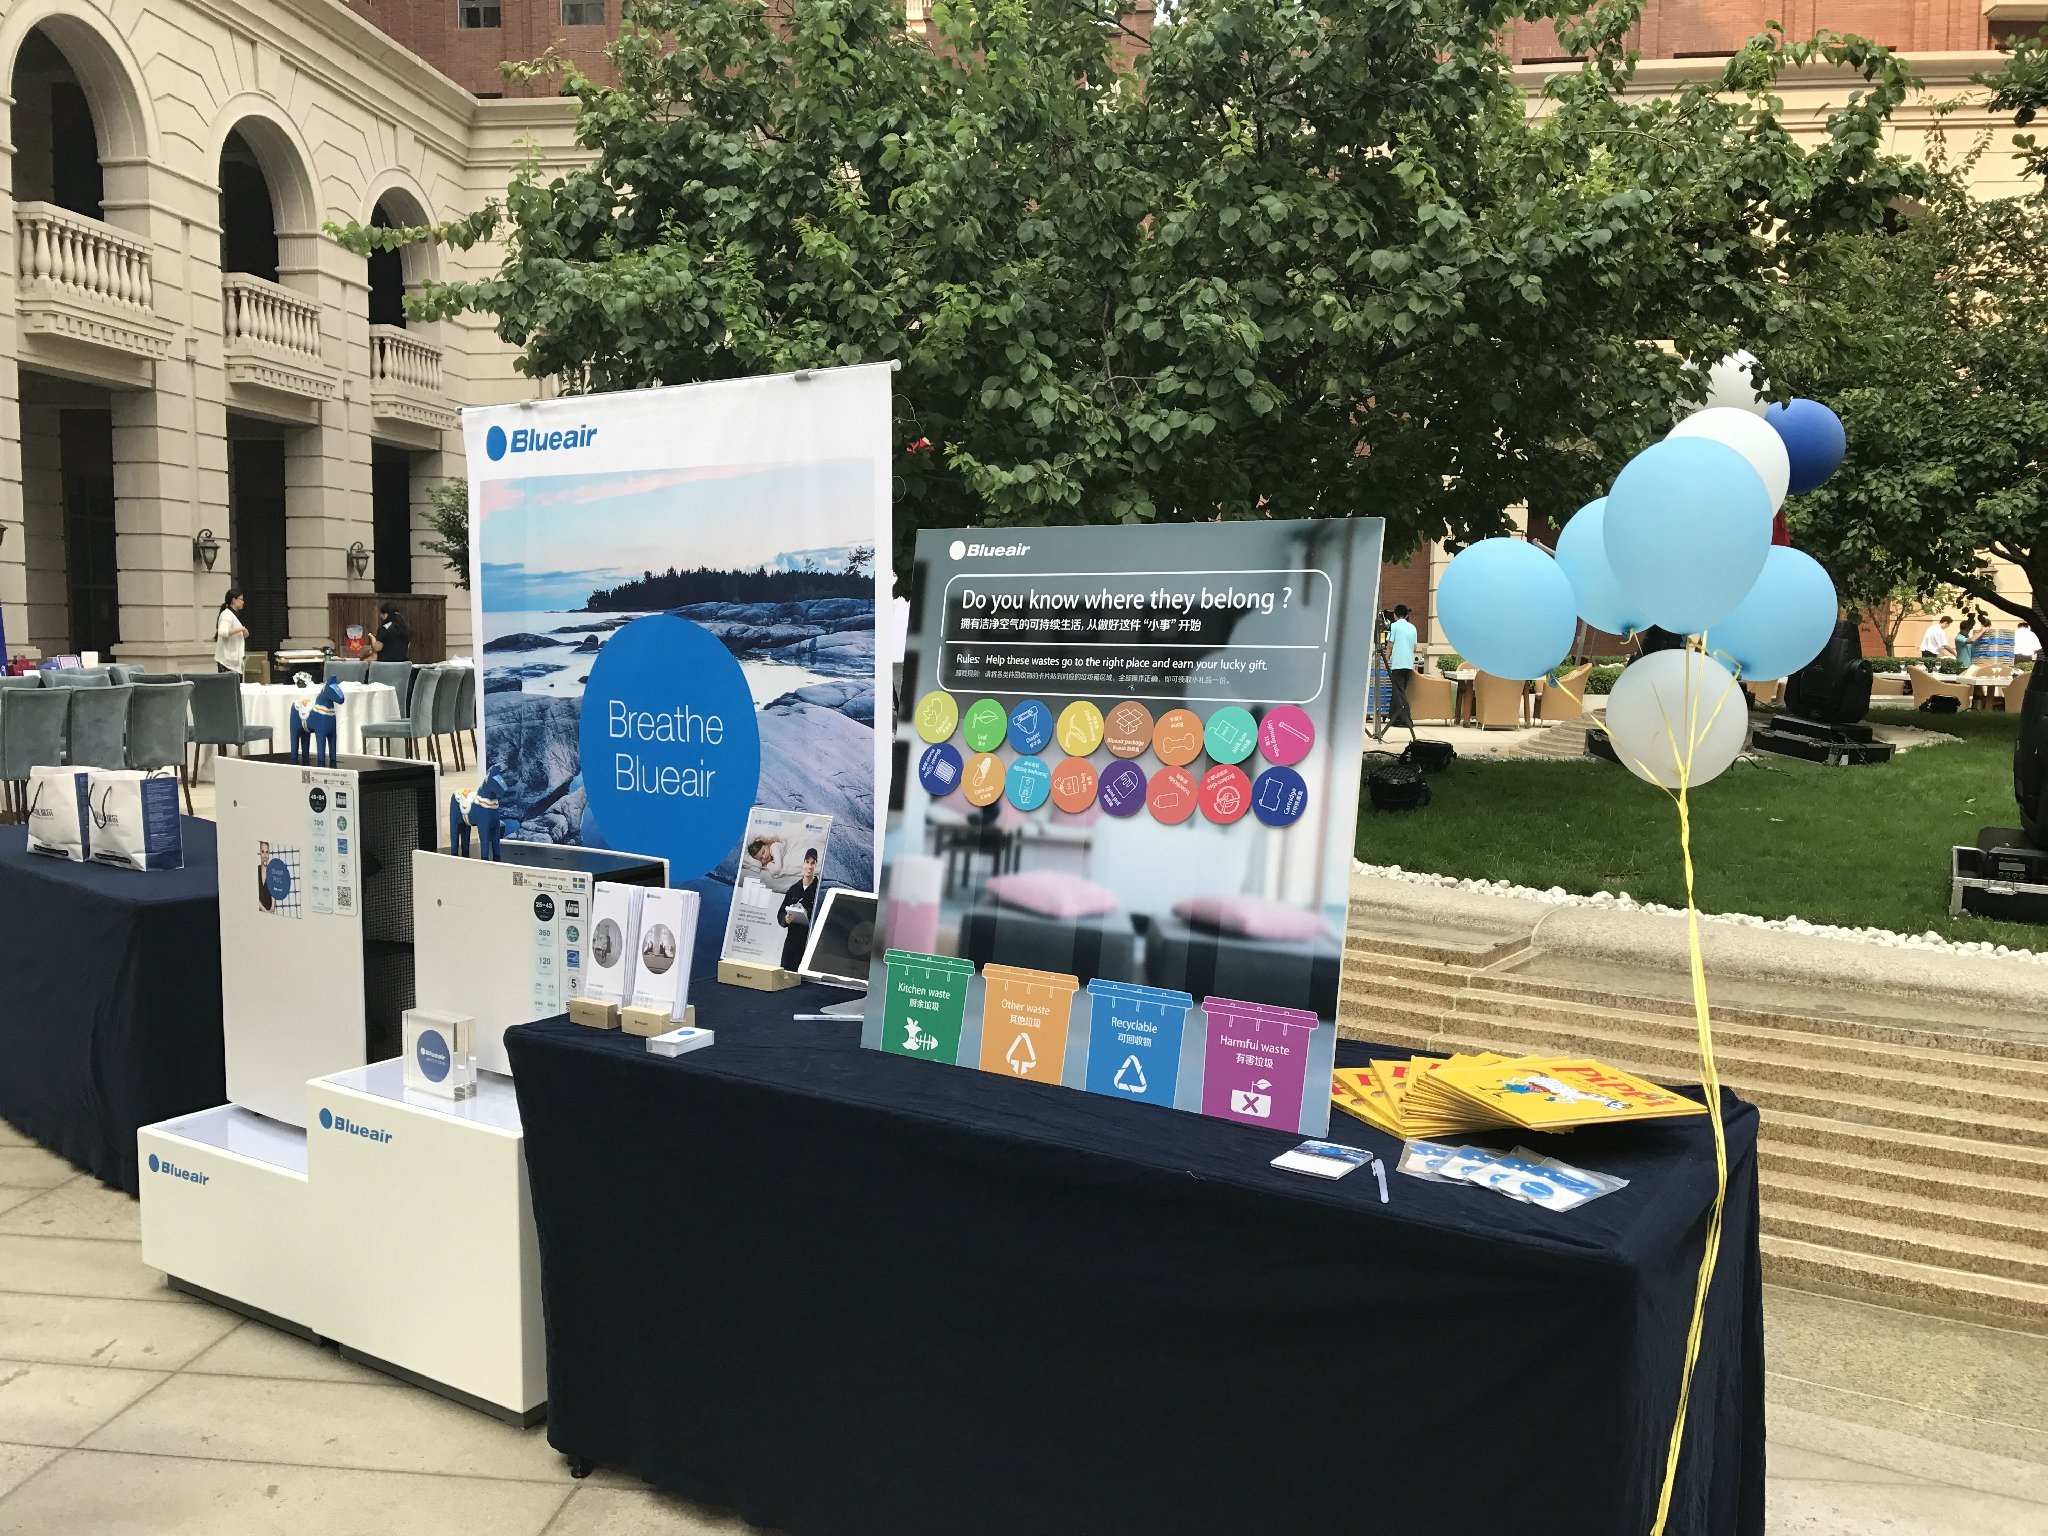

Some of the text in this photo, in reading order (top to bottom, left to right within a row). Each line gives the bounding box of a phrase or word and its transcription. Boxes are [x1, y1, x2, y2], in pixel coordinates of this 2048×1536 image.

[510, 424, 597, 453] Blueair
[966, 542, 1031, 558] Blueair
[962, 586, 1293, 615] Do you know where they belong ?
[956, 653, 1268, 673] Rules: Help these wastes go to the right place and earn your lucky gift.
[608, 699, 724, 746] Breathe
[1124, 739, 1145, 747] package
[615, 752, 716, 798] Blueair
[1283, 787, 1297, 815] Cartridge
[341, 865, 346, 874] 5
[538, 956, 551, 965] 120
[571, 978, 577, 989] 5
[897, 982, 951, 1000] Kitchen waste
[1001, 998, 1050, 1016] Other waste
[1111, 1016, 1158, 1034] Recyclable
[1117, 1032, 1152, 1048] 可回收物
[1220, 1034, 1290, 1056] Harmful waste
[425, 1049, 446, 1061] Blueair
[1236, 1052, 1274, 1069] 有害垃圾
[334, 1116, 393, 1144] Blueair
[161, 1160, 209, 1186] Blueair
